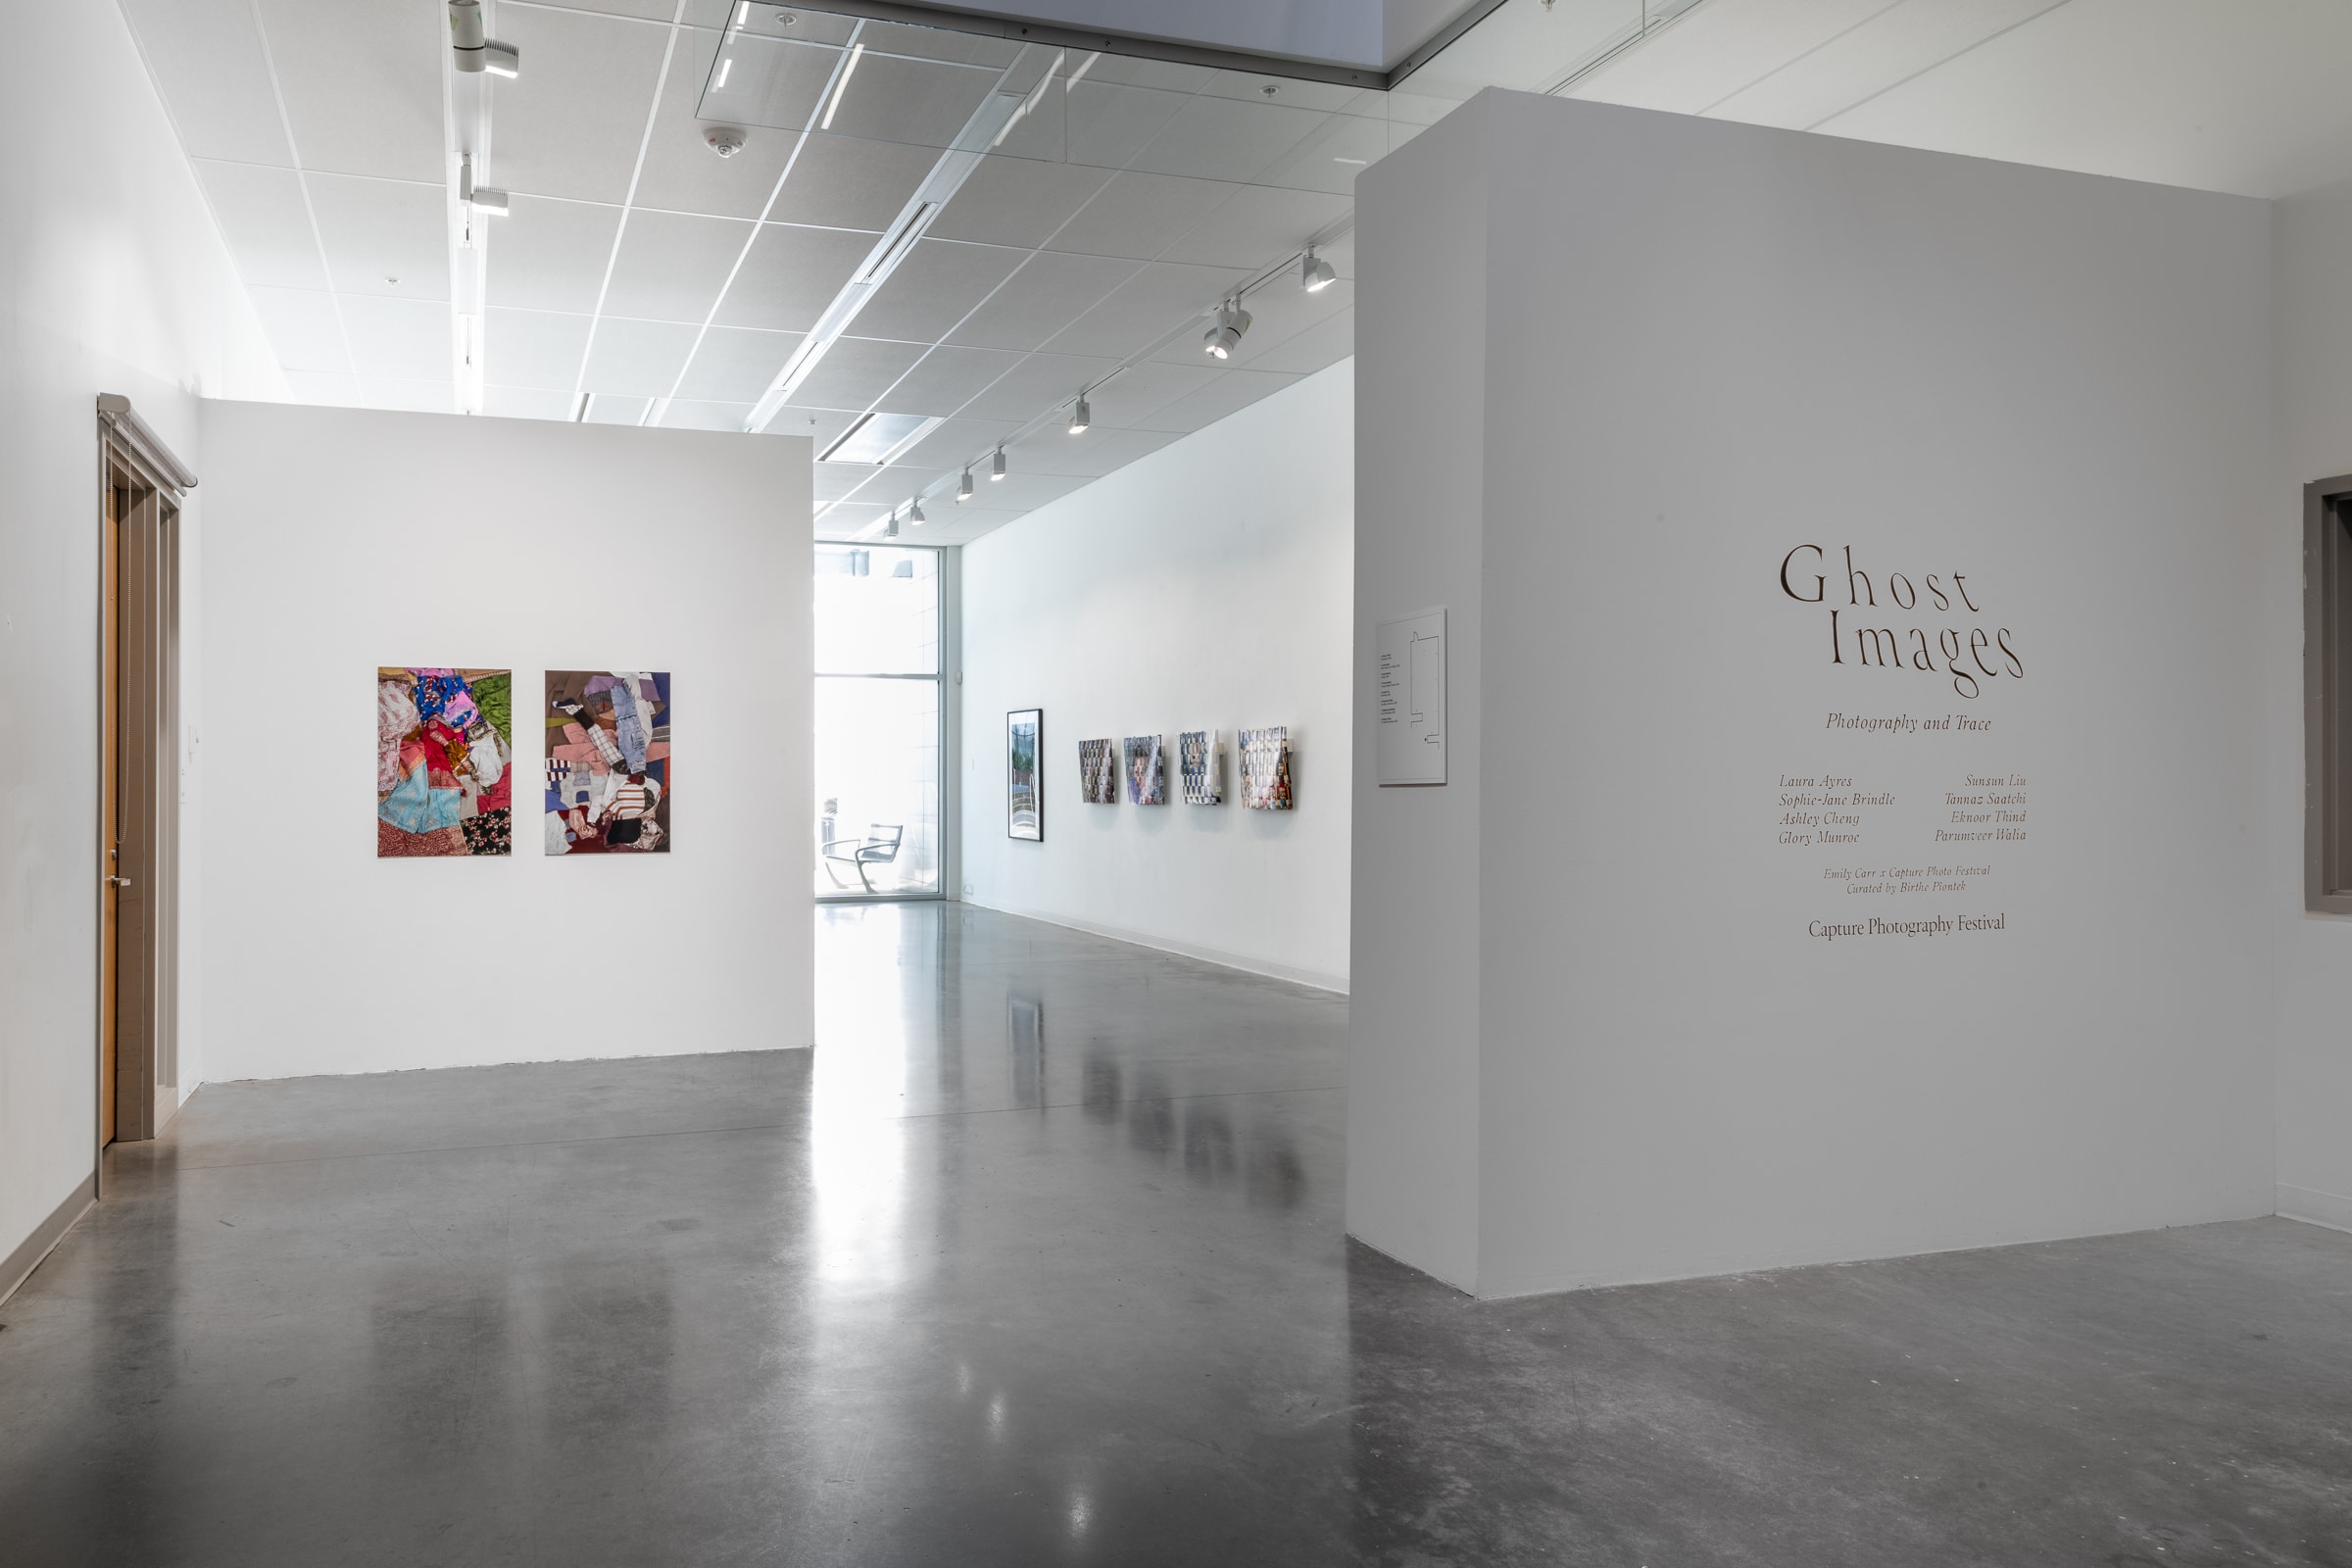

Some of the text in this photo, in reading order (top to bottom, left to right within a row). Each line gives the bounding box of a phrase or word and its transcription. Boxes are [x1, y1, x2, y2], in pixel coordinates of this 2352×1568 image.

[1781, 545, 1979, 612] Ghost
[1830, 610, 2023, 699] Images
[1827, 713, 1990, 733] Photography and Trace
[1780, 774, 1852, 789] Laura Ayres
[1965, 774, 2026, 786] Sunsun Liu
[1780, 793, 1894, 808] Sophie-Jane Brindle
[1945, 793, 2026, 805] Tannaz Saatchi
[1780, 811, 1859, 827] Ashley Cheng
[1951, 810, 2026, 822] Eknoor Thind
[1780, 831, 1859, 846] Glory Munroe
[1996, 828, 2026, 840] Walia
[1825, 868, 1851, 880] Emily
[1855, 868, 1876, 878] Carr
[1889, 867, 1923, 879] Capture
[1927, 866, 1951, 876] Photo
[1956, 865, 1990, 875] Festival
[1847, 881, 1966, 895] Curated by Birthe Piontek
[1809, 912, 2004, 941] Capture Photography Festival
